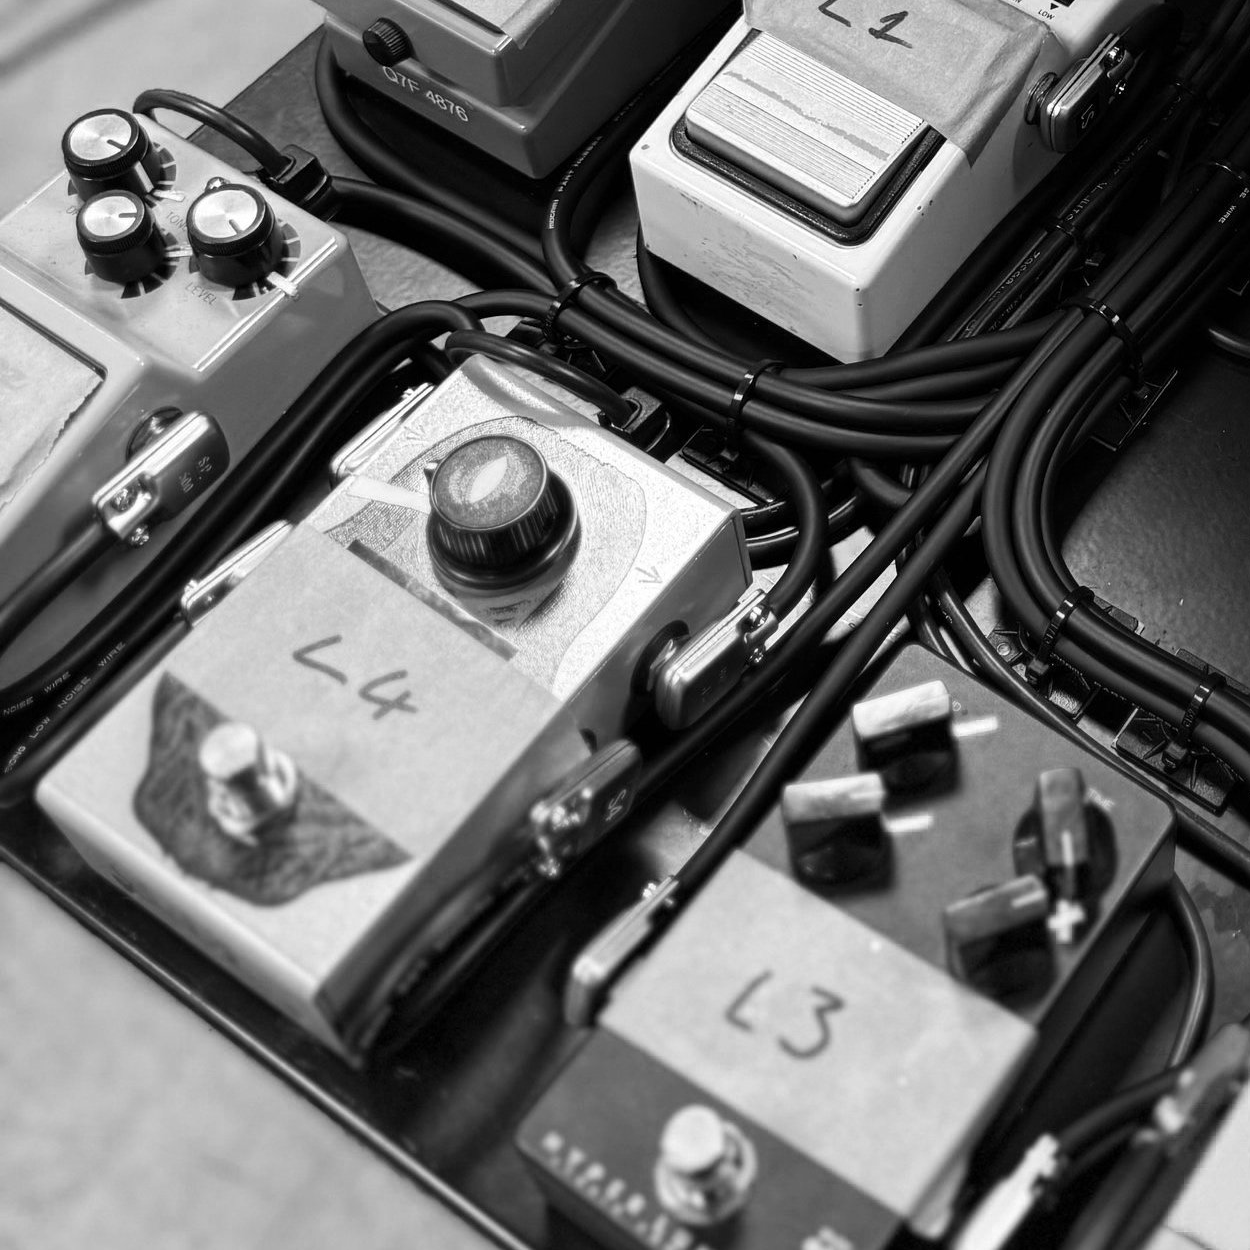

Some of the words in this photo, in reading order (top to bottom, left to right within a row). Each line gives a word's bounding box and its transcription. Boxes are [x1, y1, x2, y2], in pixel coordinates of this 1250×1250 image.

[1038, 9, 1054, 21] LOW
[424, 88, 470, 123] 4876
[1218, 205, 1237, 224] WIRE
[185, 281, 218, 306] LEVEL
[3, 696, 34, 716] NOISE
[44, 671, 71, 693] WIRE
[29, 716, 51, 739] LOW
[58, 676, 92, 709] NOISE
[98, 641, 126, 668] WIRE
[292, 633, 419, 720] L4
[725, 970, 847, 1060] L3
